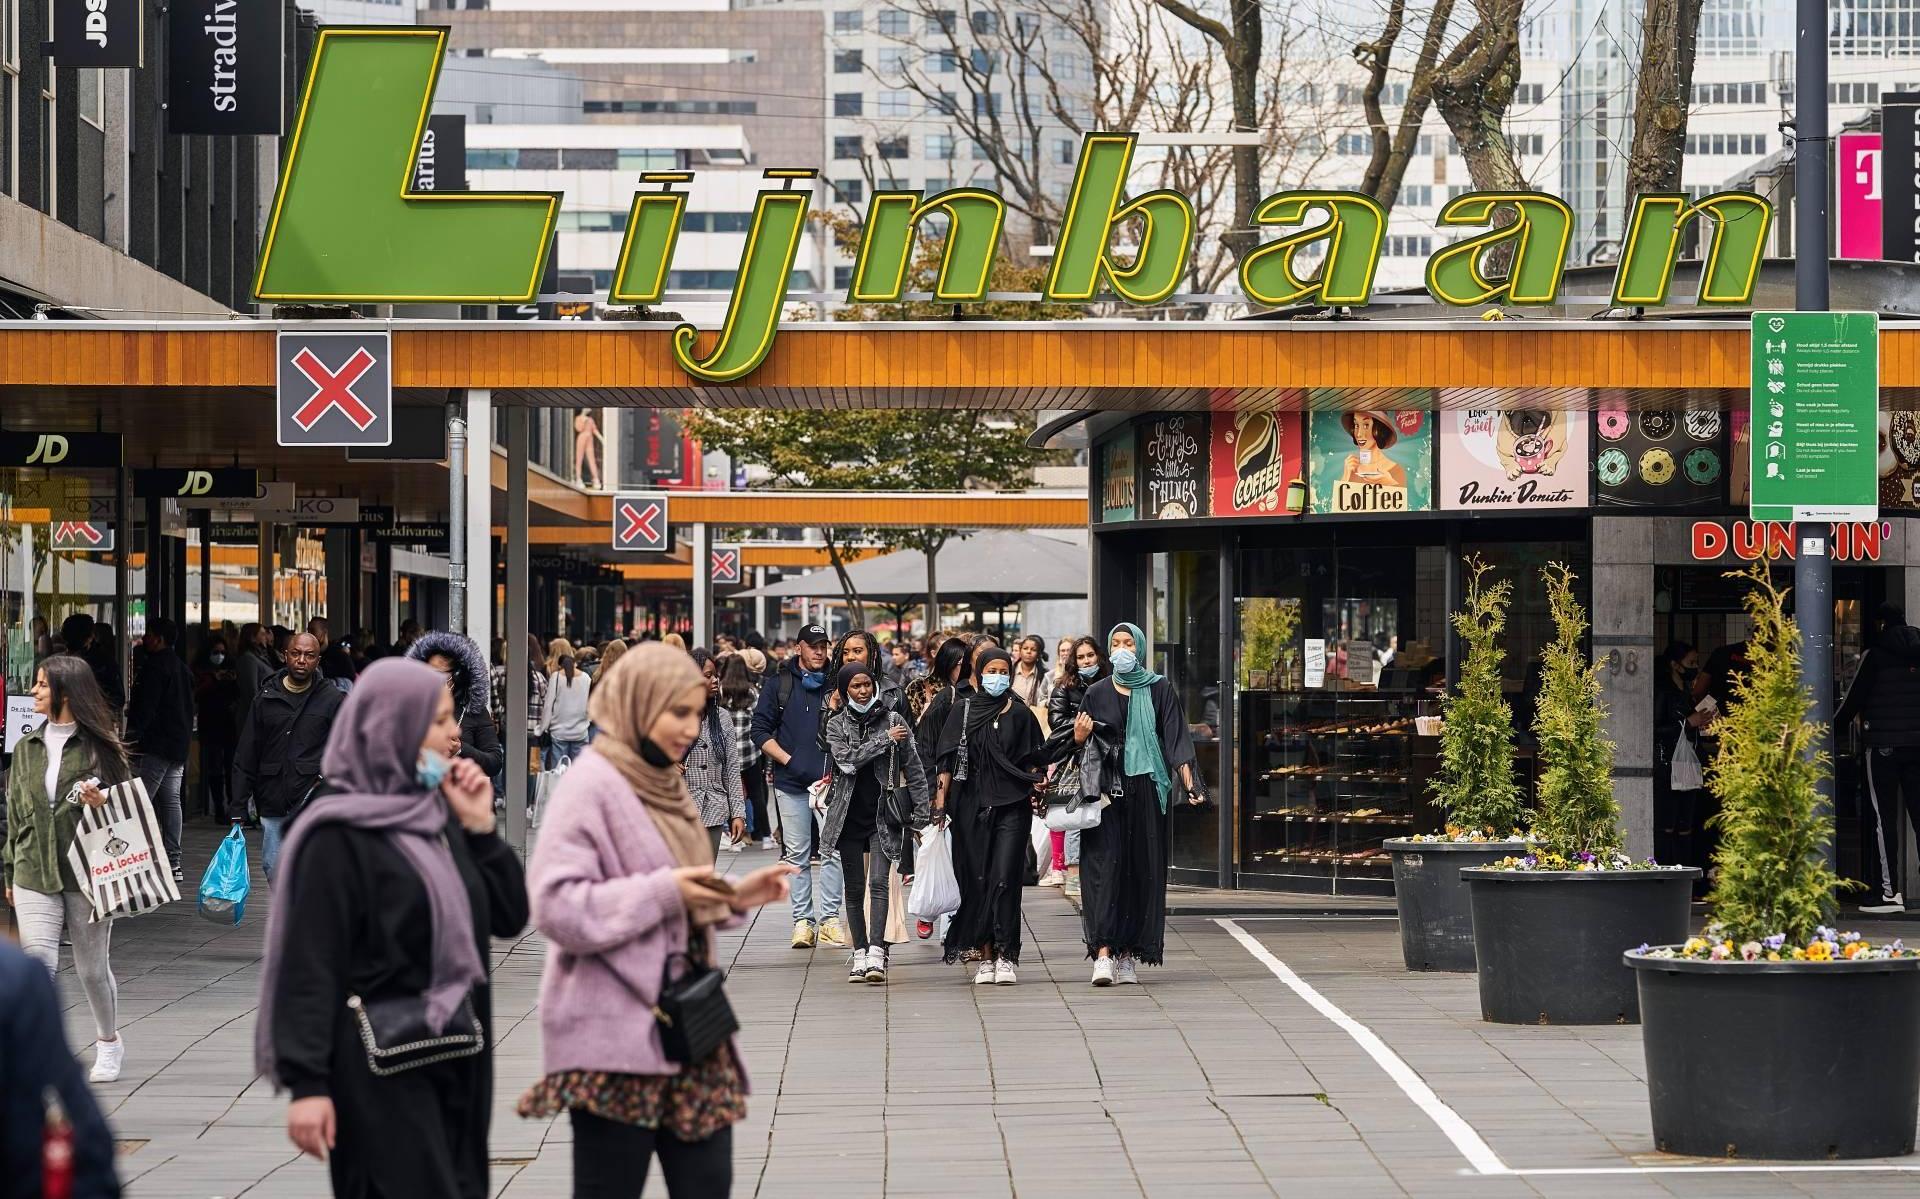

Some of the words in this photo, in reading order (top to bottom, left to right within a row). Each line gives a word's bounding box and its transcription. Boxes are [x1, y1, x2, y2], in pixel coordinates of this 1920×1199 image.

[249, 25, 1774, 382] Lijnbaan
[1463, 416, 1495, 438] Sweet
[26, 435, 69, 464] JD
[178, 471, 213, 495] JD
[1235, 460, 1282, 506] COFFEE
[1340, 483, 1403, 511] Coffee
[1459, 480, 1516, 505] Dunkin'
[1517, 479, 1575, 504] Donuts
[1148, 480, 1198, 515] THINGS
[376, 525, 445, 538] stradivarius
[1691, 520, 1892, 561] DUNIN'
[1608, 648, 1638, 677] 98
[116, 850, 149, 869] locker
